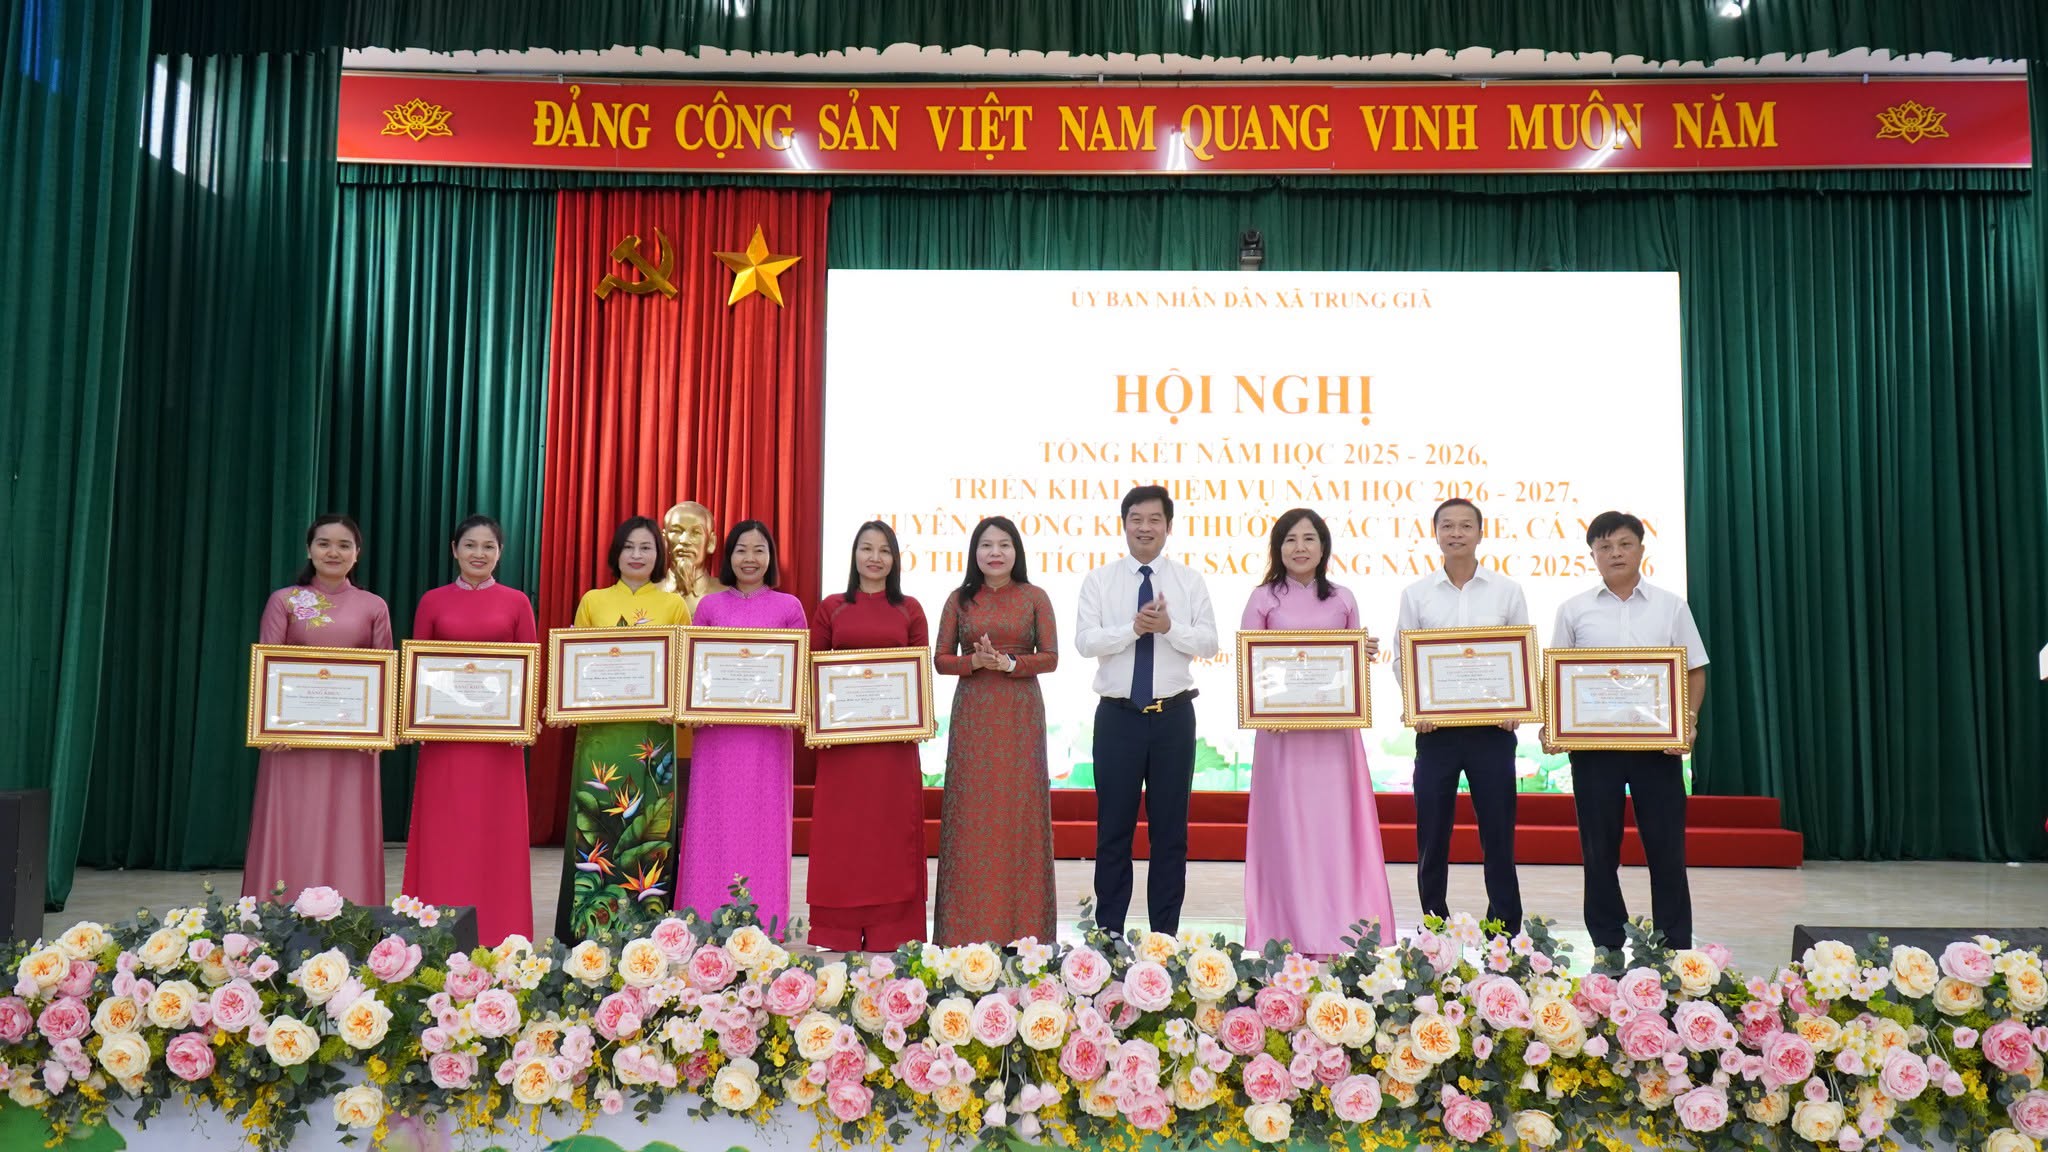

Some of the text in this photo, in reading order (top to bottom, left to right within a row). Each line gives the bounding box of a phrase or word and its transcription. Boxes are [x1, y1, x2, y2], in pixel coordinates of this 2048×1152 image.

[533, 86, 1778, 160] ĐẢNG CỘNG SẢN VIỆT NAM QUANG VINH MUÔN NĂM
[1106, 291, 1149, 308] BAN
[1156, 286, 1216, 309] NHÂN
[1223, 287, 1268, 309] DÂN
[1275, 287, 1305, 309] XÃ
[1310, 291, 1387, 309] TRUNG
[1114, 367, 1374, 427] HỘI NGHỊ
[1197, 437, 1262, 465] NĂM
[1272, 442, 1334, 470] HỌC
[1343, 443, 1400, 465] 2025
[1424, 443, 1488, 468] 2026,
[1048, 478, 1121, 500] KHAI
[1236, 480, 1276, 507] VỤ
[1285, 475, 1350, 502] NĂM
[1361, 480, 1422, 508] HỌC
[1432, 480, 1489, 503] 2026
[1526, 512, 1566, 540] CÁ
[1036, 545, 1107, 574] TÍCH
